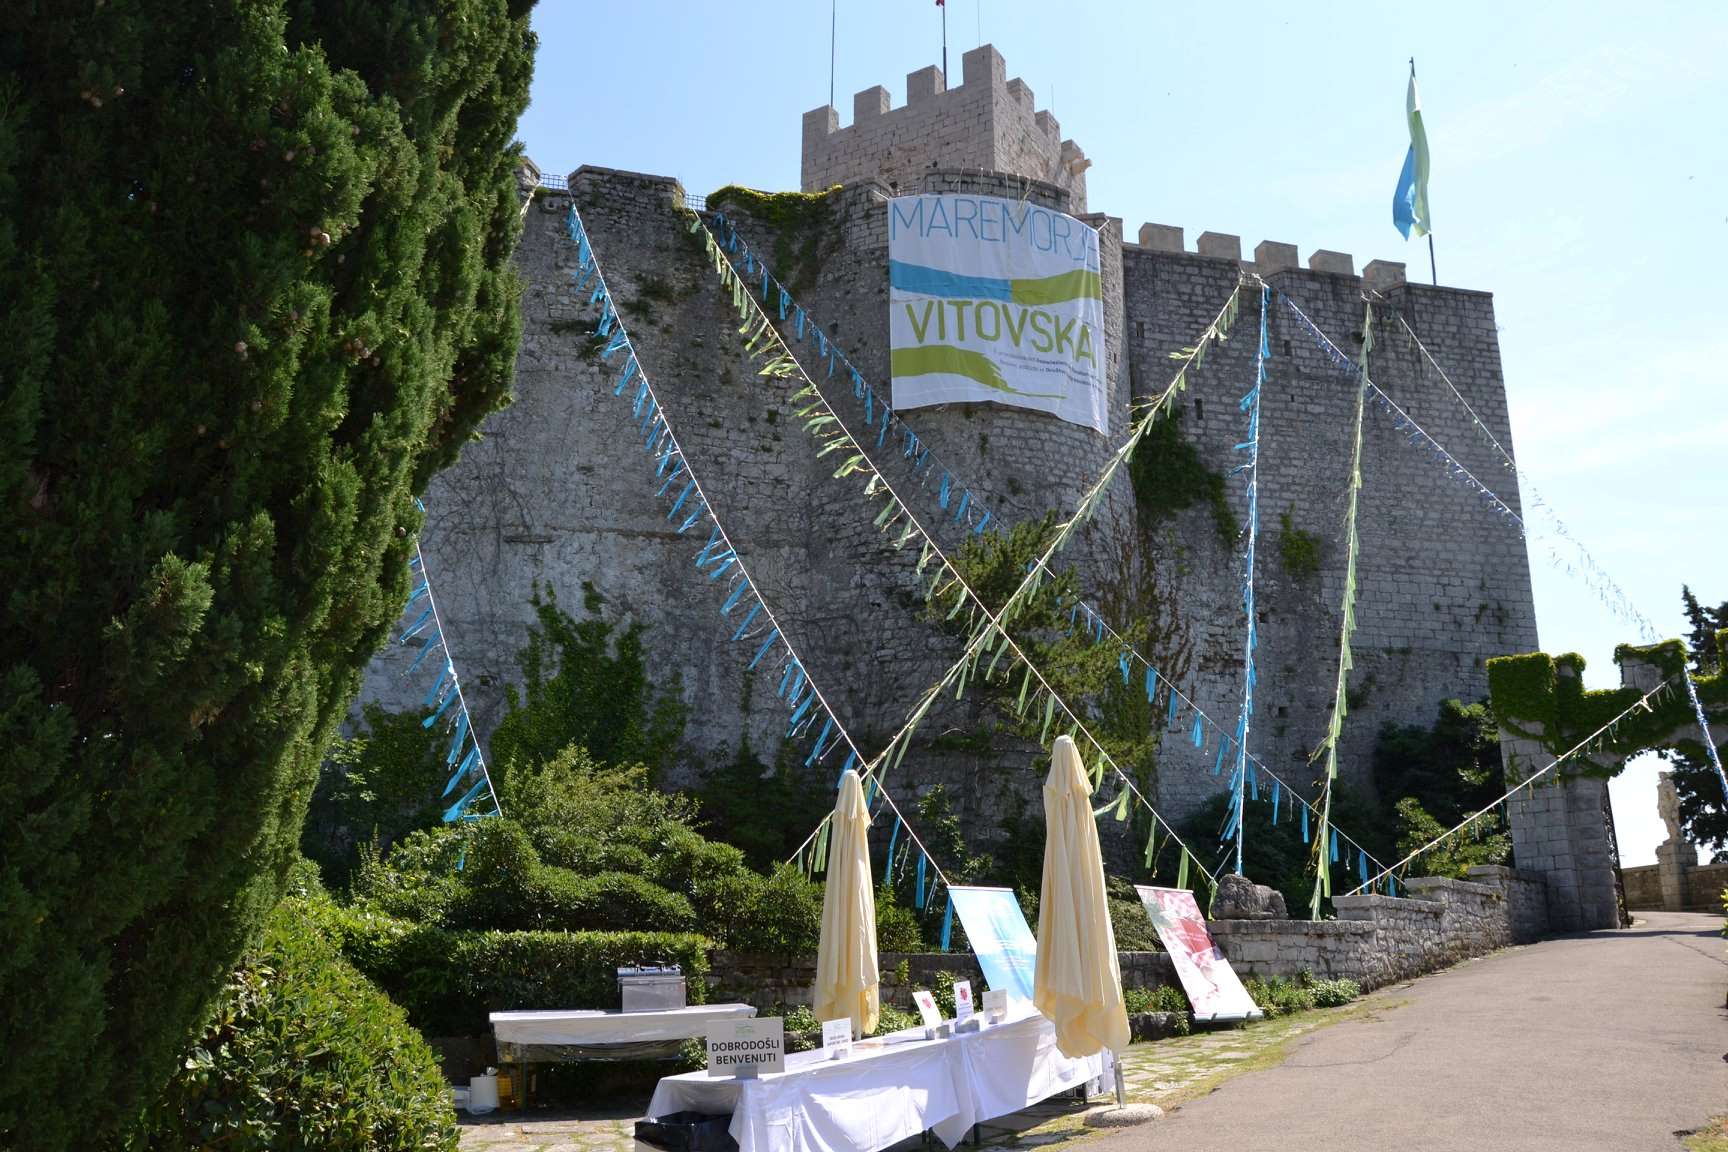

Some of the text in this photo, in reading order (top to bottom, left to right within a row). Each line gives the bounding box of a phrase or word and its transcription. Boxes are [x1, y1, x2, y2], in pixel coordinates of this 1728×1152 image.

[905, 300, 1096, 368] VITOVSKA
[711, 1037, 779, 1052] DOBRODOŠLI
[716, 1053, 776, 1065] BENVENUTI
